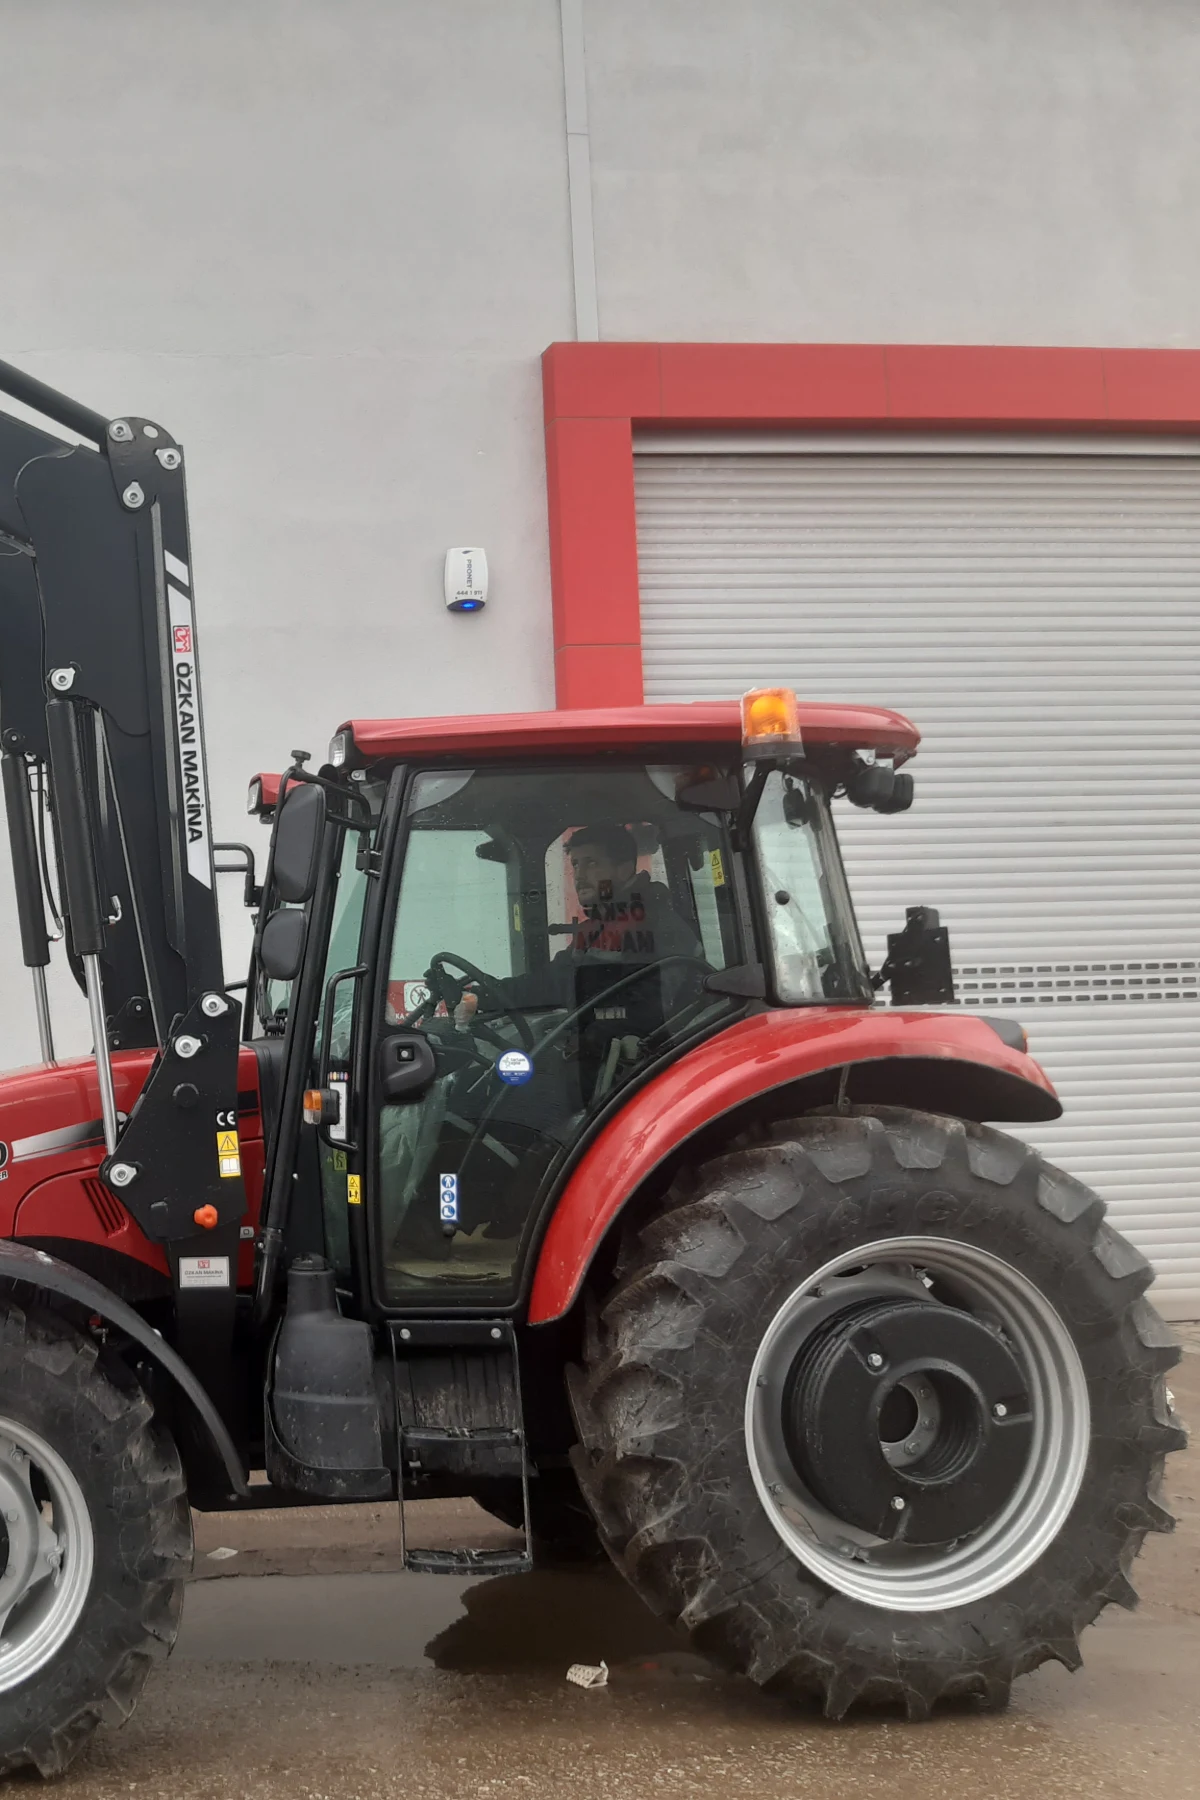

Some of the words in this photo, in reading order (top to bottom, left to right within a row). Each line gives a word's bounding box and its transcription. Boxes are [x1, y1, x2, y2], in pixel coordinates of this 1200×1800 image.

[176, 661, 196, 745] ÖZKAN
[182, 750, 203, 844] MAKİNA
[216, 1111, 236, 1126] CE
